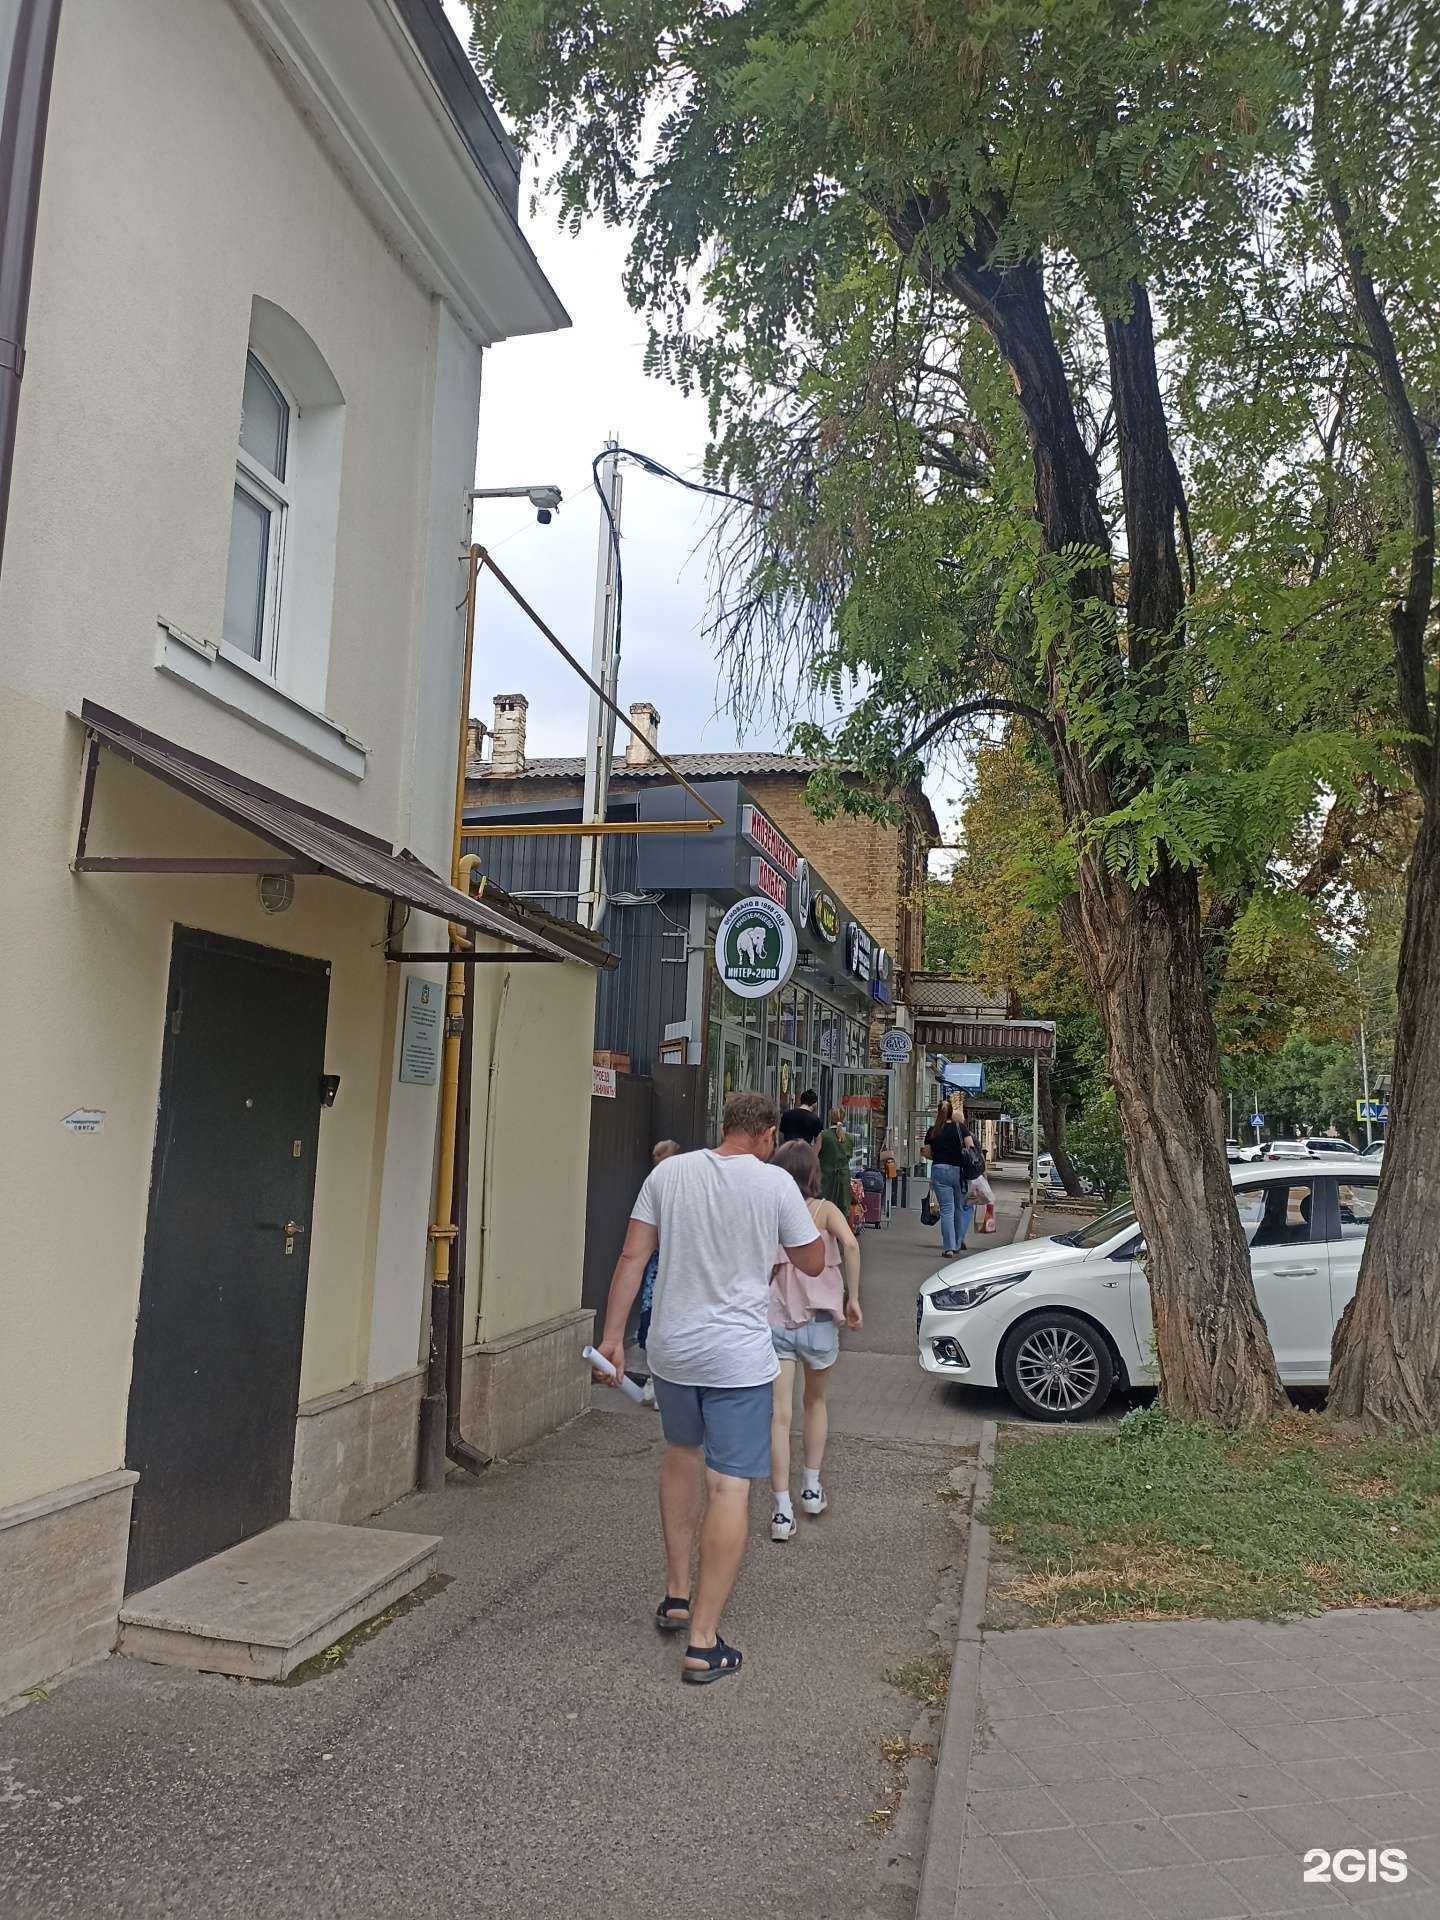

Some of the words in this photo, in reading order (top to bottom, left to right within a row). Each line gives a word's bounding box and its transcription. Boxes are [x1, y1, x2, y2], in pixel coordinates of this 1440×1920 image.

[724, 901, 754, 926] ОСНОВАНО
[774, 911, 786, 927] ГОДУ
[735, 912, 774, 929] ИНОЗЕМЦЕВО
